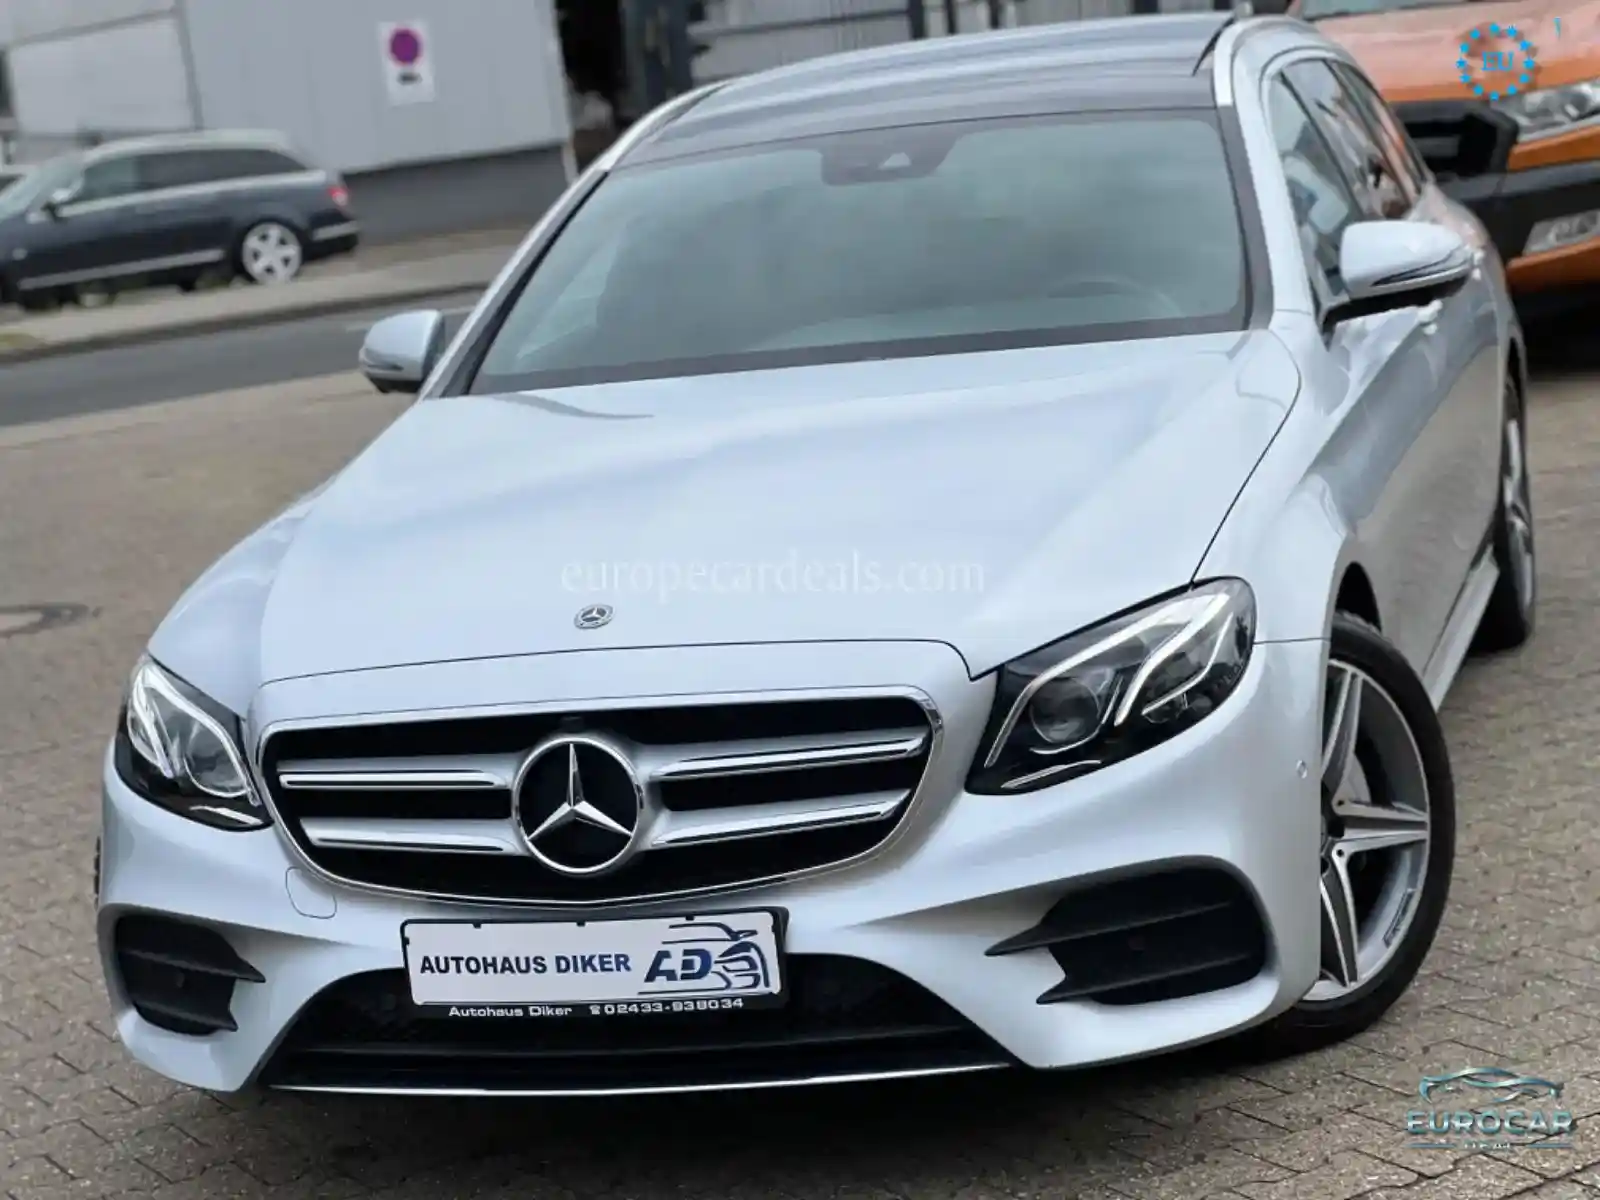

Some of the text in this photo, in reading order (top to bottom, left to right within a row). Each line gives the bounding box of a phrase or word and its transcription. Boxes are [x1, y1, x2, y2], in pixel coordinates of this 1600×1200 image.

[419, 954, 548, 975] AUTOHAUS
[554, 952, 633, 974] DIKER
[448, 1005, 524, 1018] Autohaus
[528, 1004, 574, 1017] Diker
